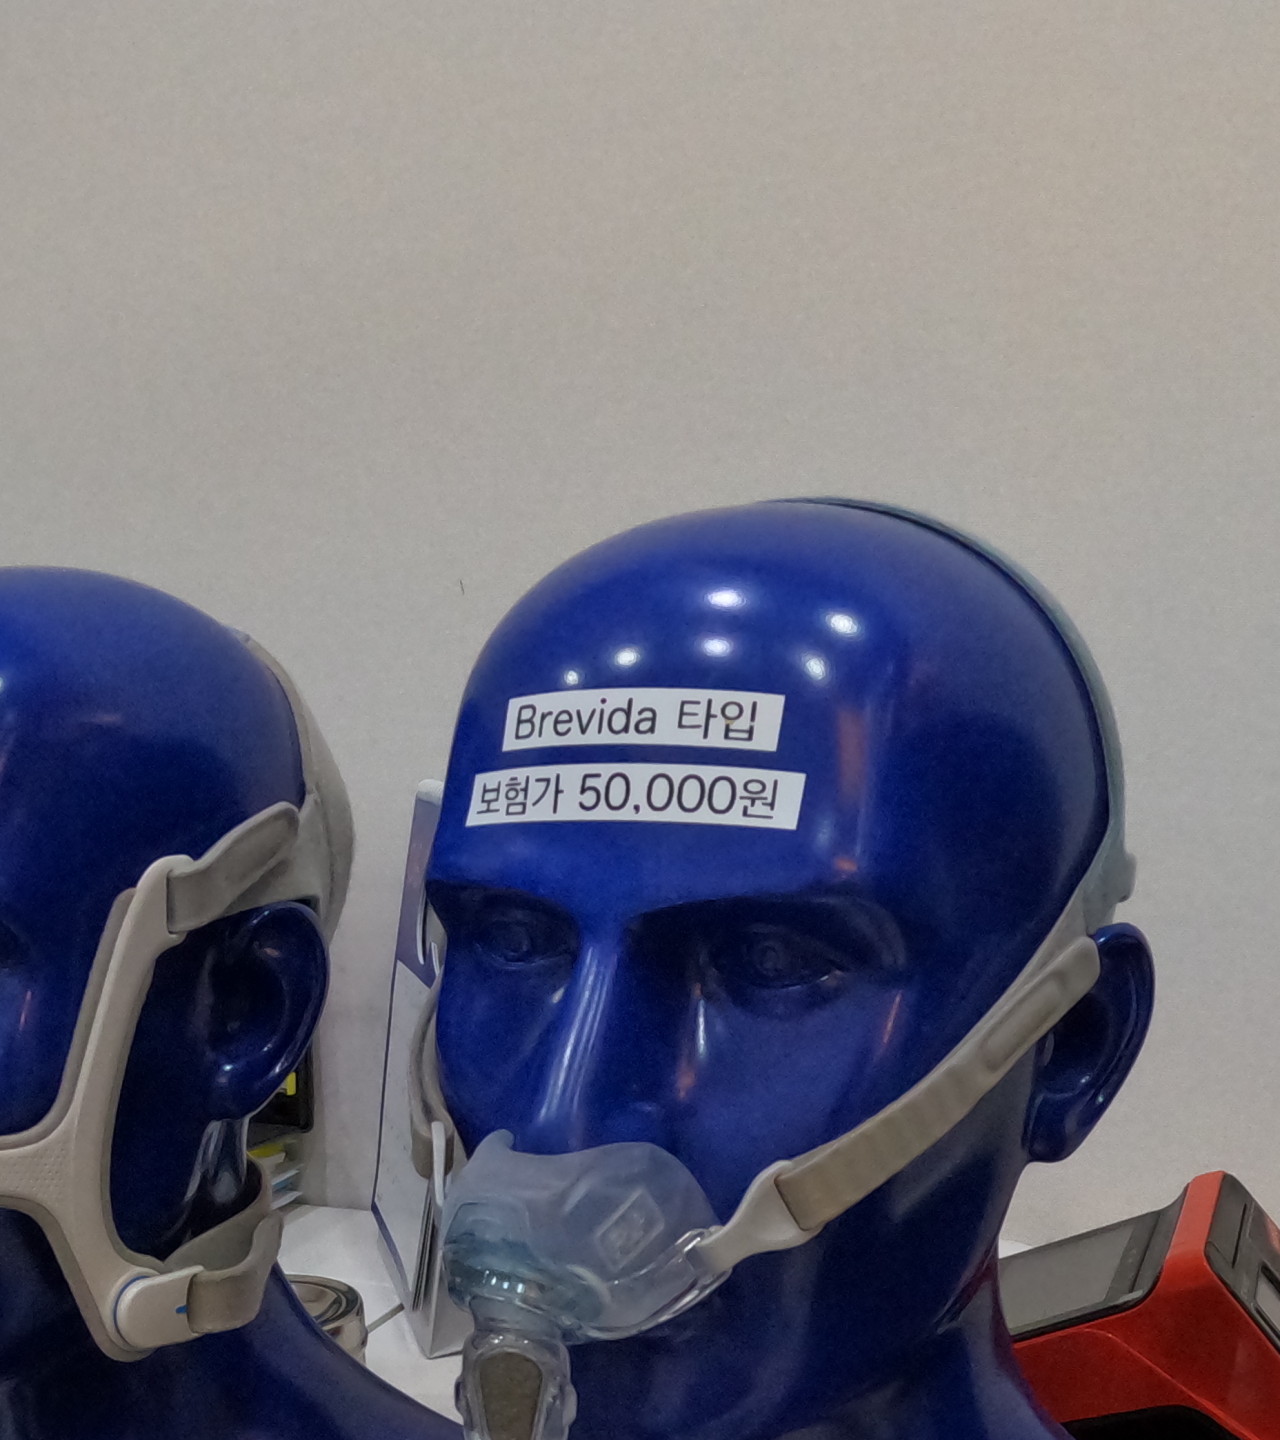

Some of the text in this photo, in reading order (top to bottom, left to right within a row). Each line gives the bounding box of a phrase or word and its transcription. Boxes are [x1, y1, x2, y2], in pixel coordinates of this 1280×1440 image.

[513, 697, 759, 742] Brevida 타입
[475, 771, 779, 820] 보험가 50,000원
